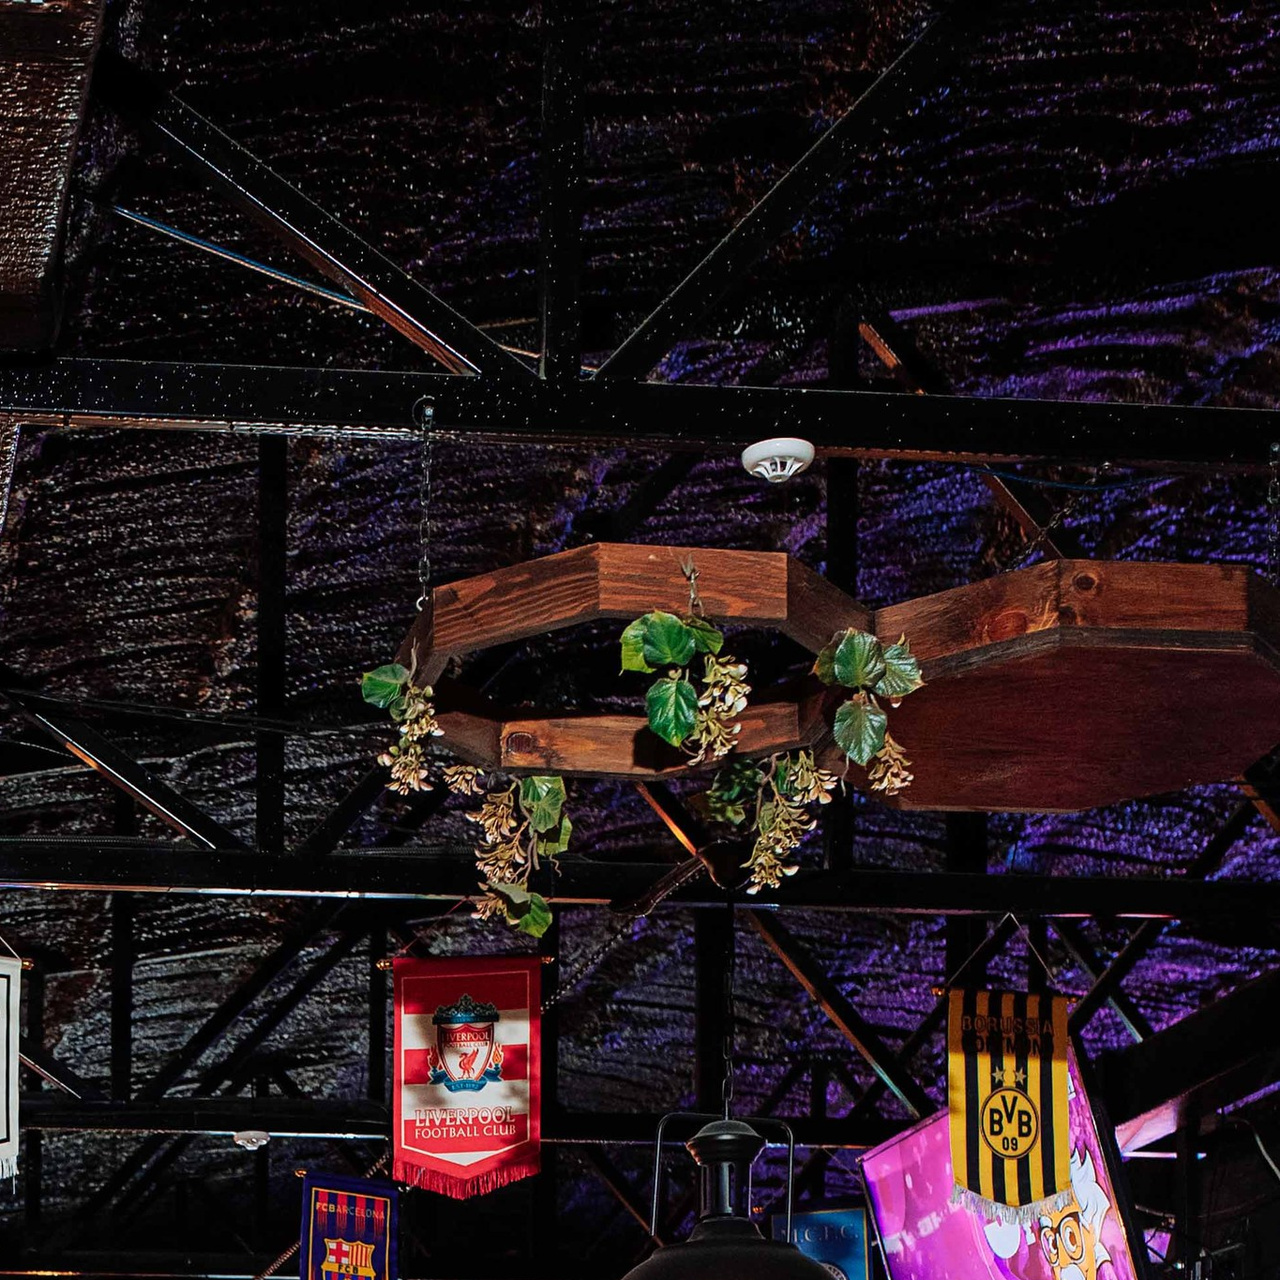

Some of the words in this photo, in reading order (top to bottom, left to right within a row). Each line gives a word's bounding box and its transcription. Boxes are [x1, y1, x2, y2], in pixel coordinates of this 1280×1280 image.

[415, 1105, 516, 1127] LIVERPOOL
[990, 1095, 1032, 1137] BVB
[415, 1126, 480, 1139] FOOTBALL
[483, 1124, 516, 1137] CLUB
[1002, 1137, 1018, 1151] 09
